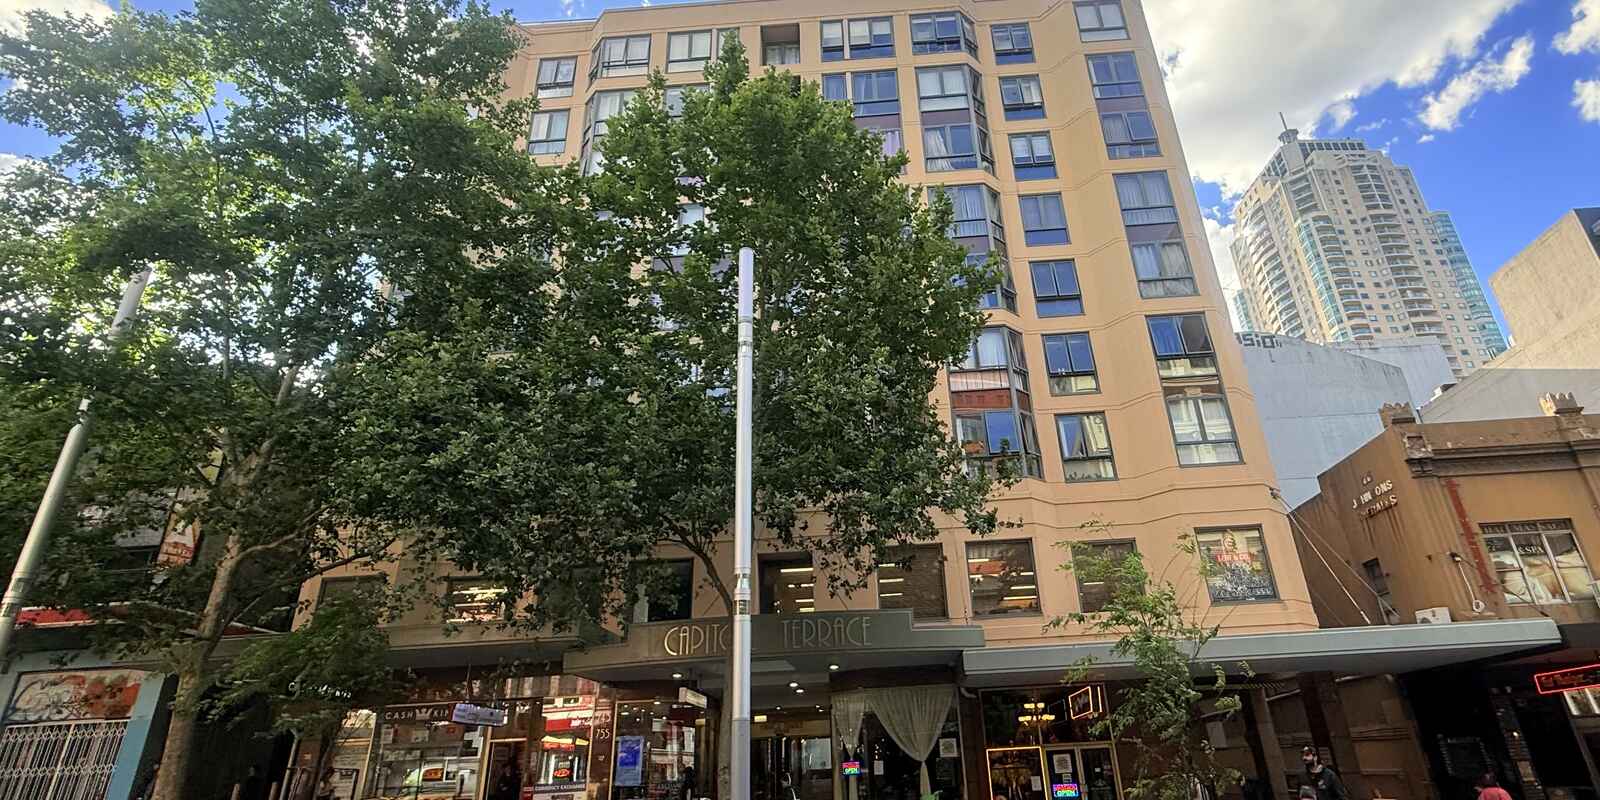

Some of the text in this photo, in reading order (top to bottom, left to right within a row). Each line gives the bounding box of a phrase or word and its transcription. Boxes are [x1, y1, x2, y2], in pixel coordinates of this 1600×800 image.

[781, 616, 873, 648] TERRACE
[384, 710, 414, 721] CASH
[596, 728, 610, 739] 755
